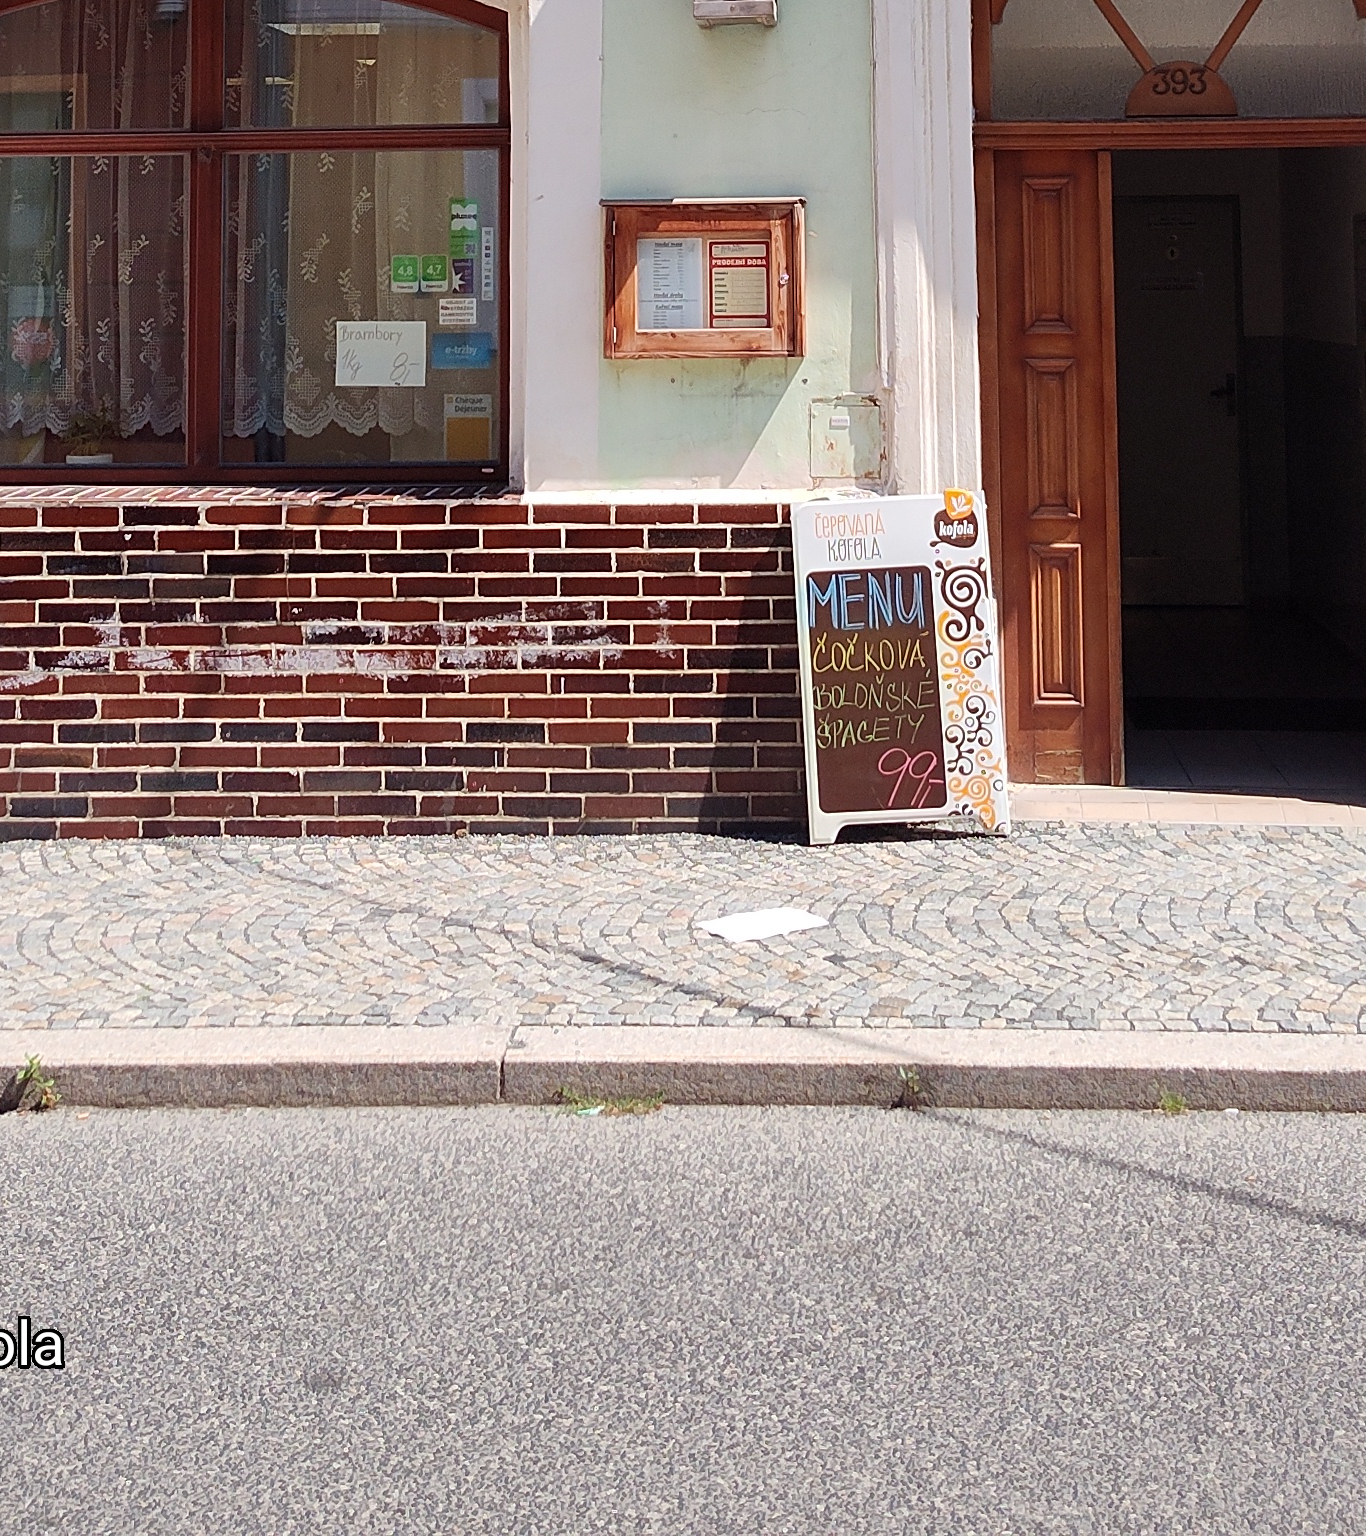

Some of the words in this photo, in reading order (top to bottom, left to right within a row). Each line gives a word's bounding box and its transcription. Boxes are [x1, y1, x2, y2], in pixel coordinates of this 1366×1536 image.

[1152, 68, 1208, 95] 393
[339, 324, 402, 346] Brambory
[939, 520, 974, 539] kofola
[827, 537, 882, 562] KOFOLA
[808, 570, 926, 630] MENU
[813, 631, 929, 672] ČOČKOVÁ
[812, 669, 935, 712] BOLOŇSKÉ
[817, 713, 925, 749] ŠPAGETY
